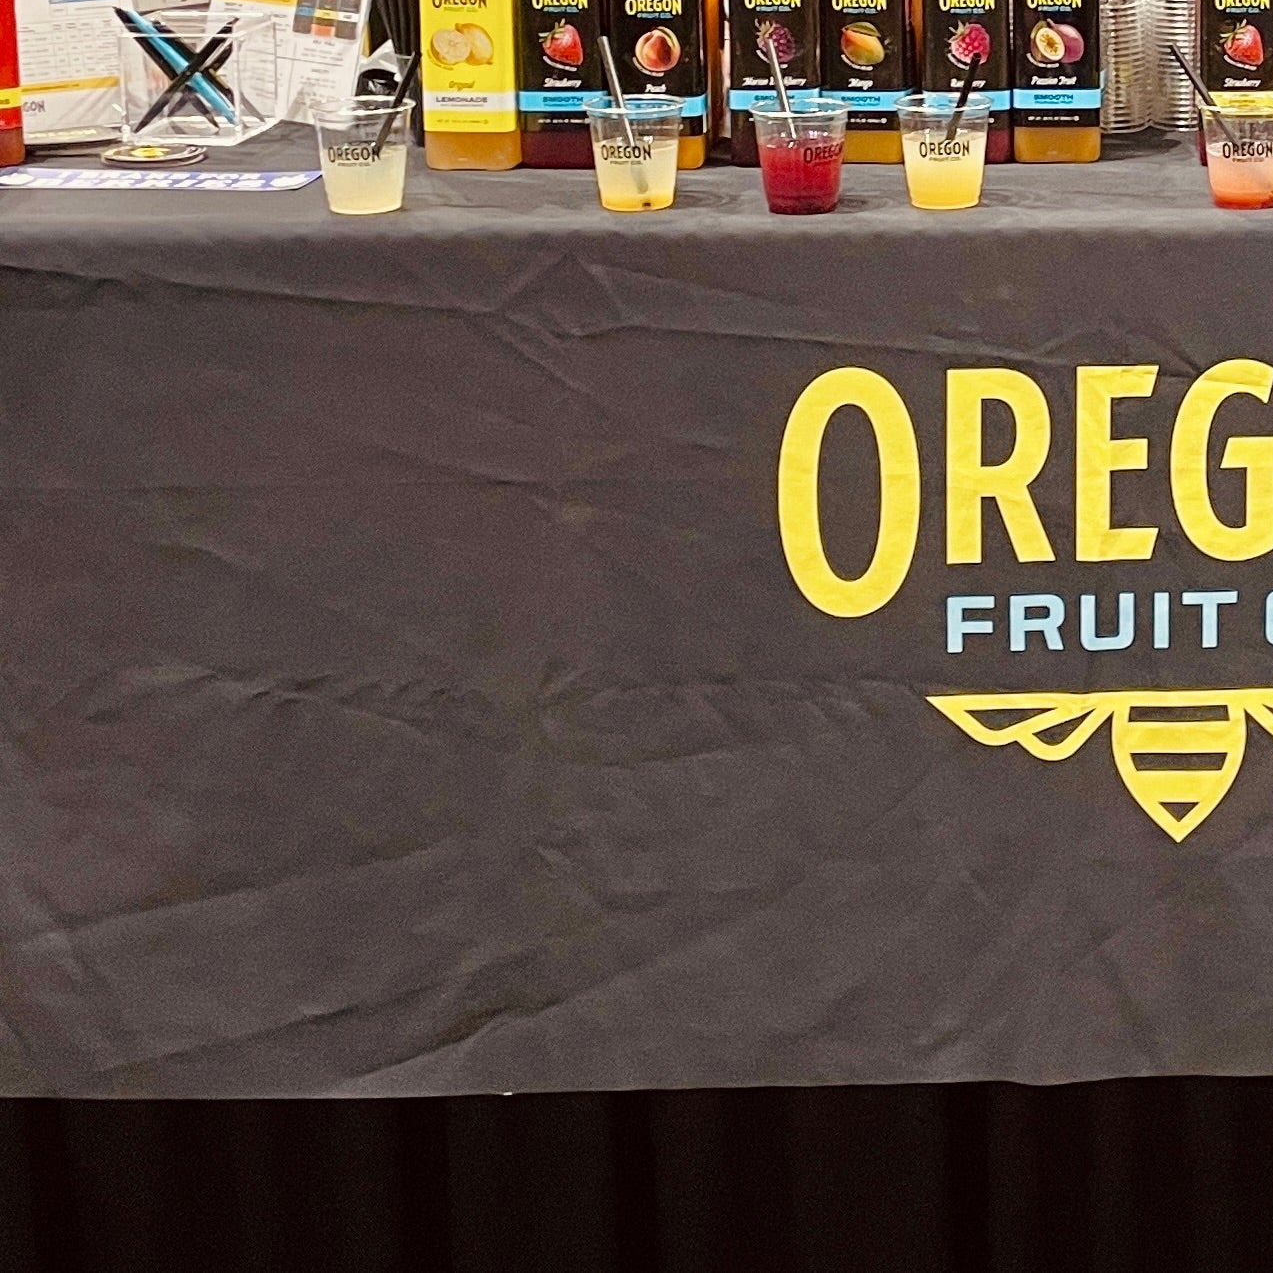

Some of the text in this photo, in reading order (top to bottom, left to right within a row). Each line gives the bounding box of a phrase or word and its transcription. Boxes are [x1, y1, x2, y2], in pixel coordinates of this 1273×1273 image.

[328, 146, 380, 162] OREGON
[601, 144, 652, 160] OREGON
[919, 140, 970, 158] OREGON
[1222, 141, 1273, 159] OREGON
[944, 590, 1239, 655] FRUIT
